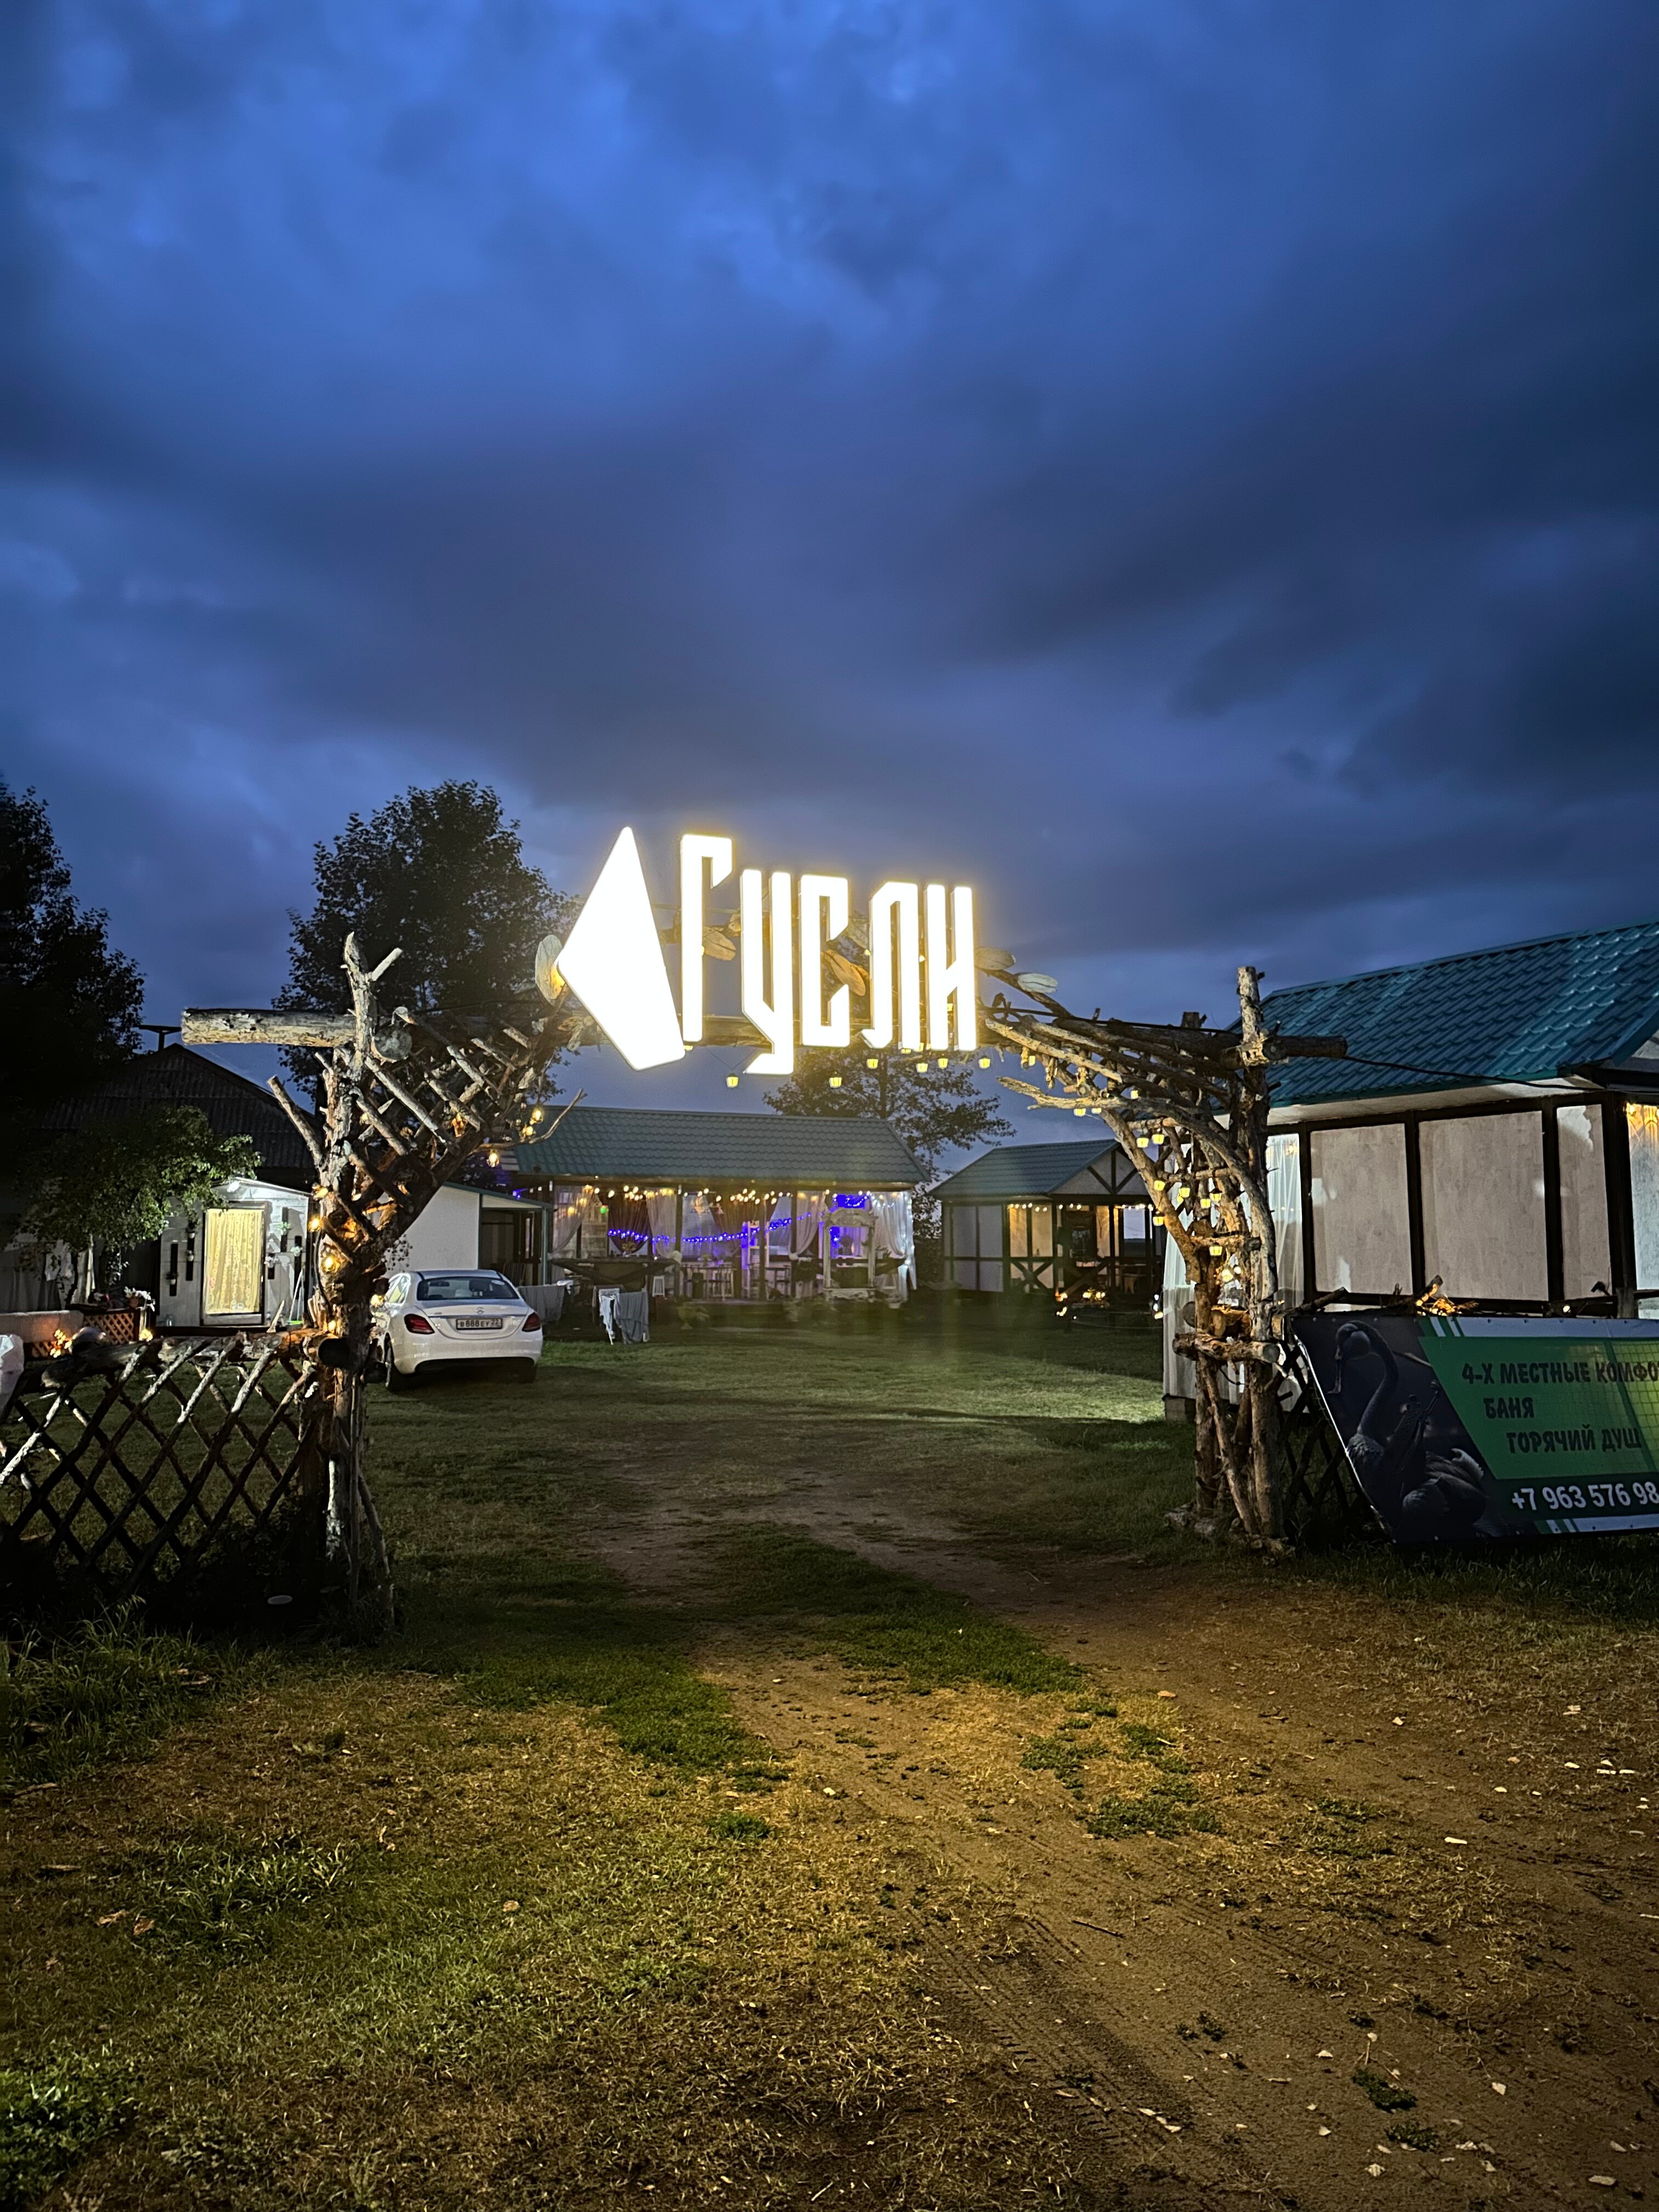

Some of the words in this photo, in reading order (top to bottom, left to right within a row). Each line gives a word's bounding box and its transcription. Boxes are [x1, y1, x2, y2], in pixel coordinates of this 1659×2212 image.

[1462, 1363, 1495, 1384] 4-Х
[1500, 1362, 1590, 1384] МЕСТНЫЕ
[1595, 1361, 1659, 1383] КОМФО
[1483, 1397, 1534, 1418] БАНЯ
[1506, 1424, 1595, 1453] ГОРЯЧИЙ
[1601, 1427, 1641, 1452] ДУШ
[1512, 1488, 1537, 1510] +7
[1542, 1485, 1586, 1509] 963
[1588, 1483, 1630, 1507] 576
[1633, 1481, 1659, 1504] 98
